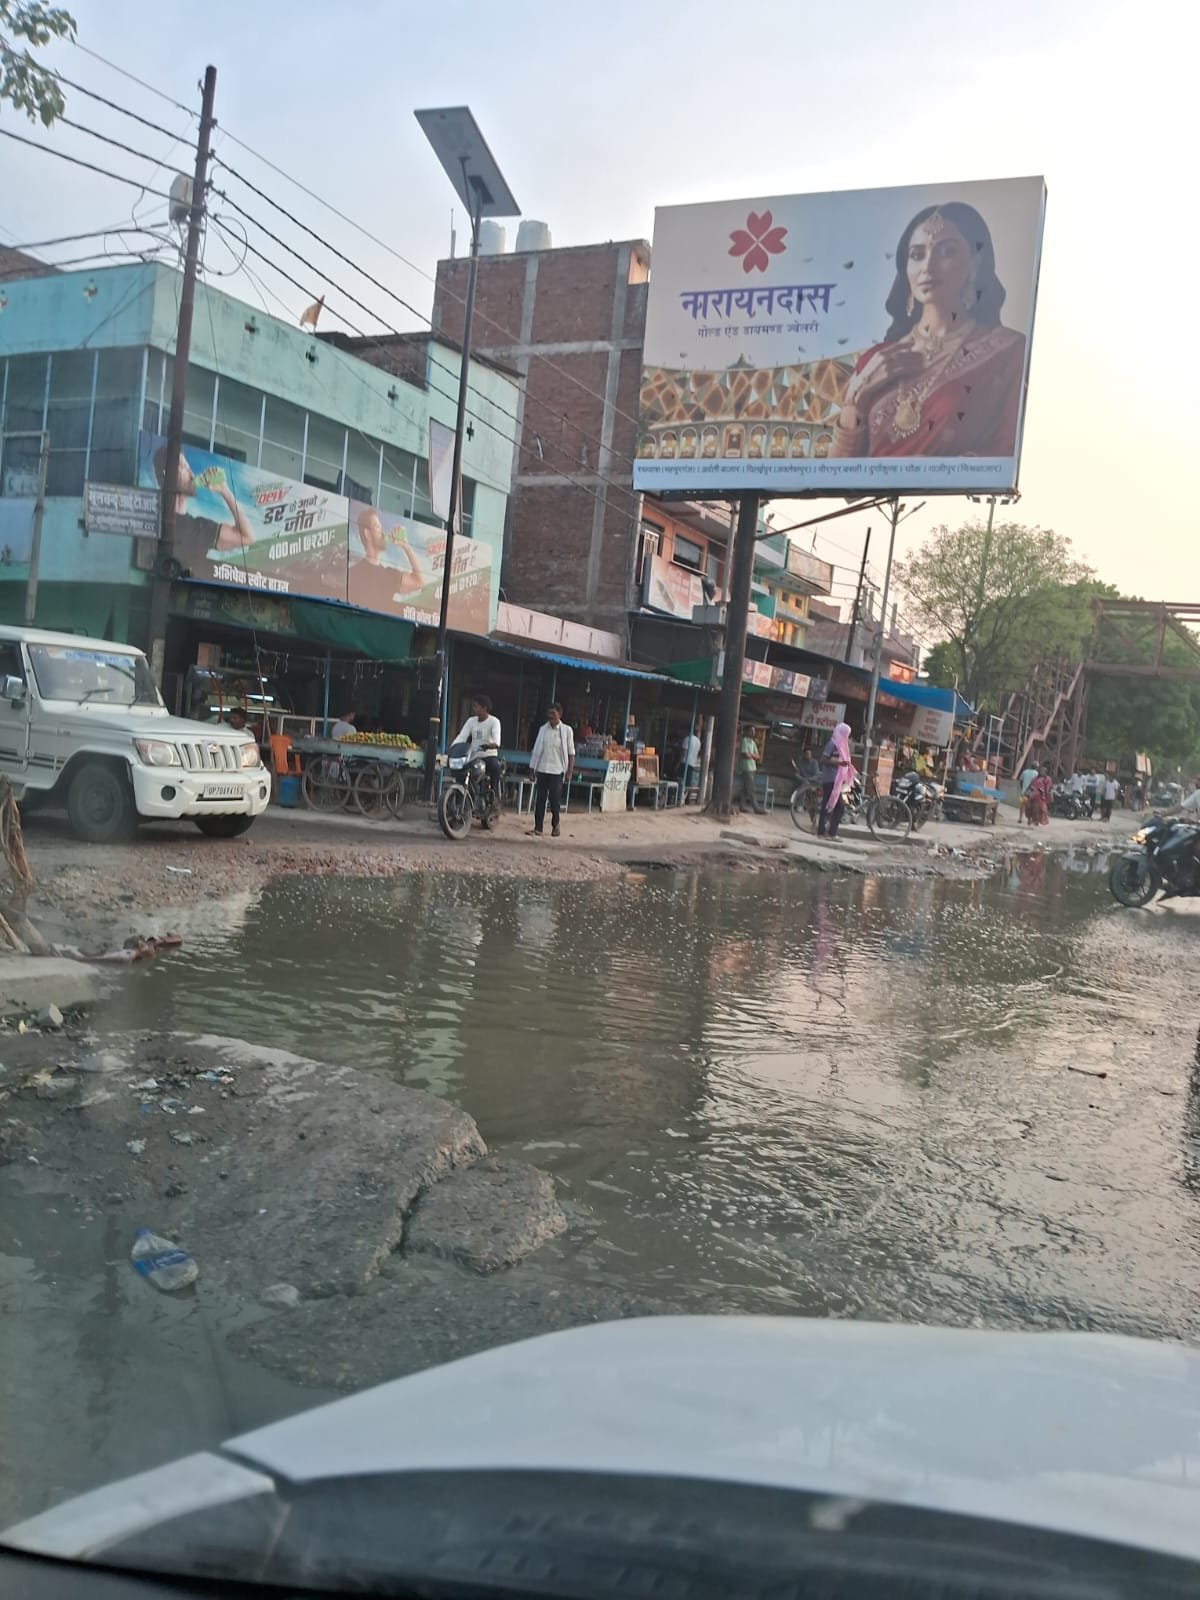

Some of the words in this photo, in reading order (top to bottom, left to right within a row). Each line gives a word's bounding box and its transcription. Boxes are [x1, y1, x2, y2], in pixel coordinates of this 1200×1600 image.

[680, 284, 837, 320] नारायनदास
[698, 326, 721, 338] गोल्ड
[264, 503, 288, 524] डर
[284, 510, 318, 532] जीत
[269, 541, 289, 561] 400
[290, 537, 301, 554] ml
[213, 563, 247, 585] अभिषेक
[247, 571, 267, 589] स्वीट
